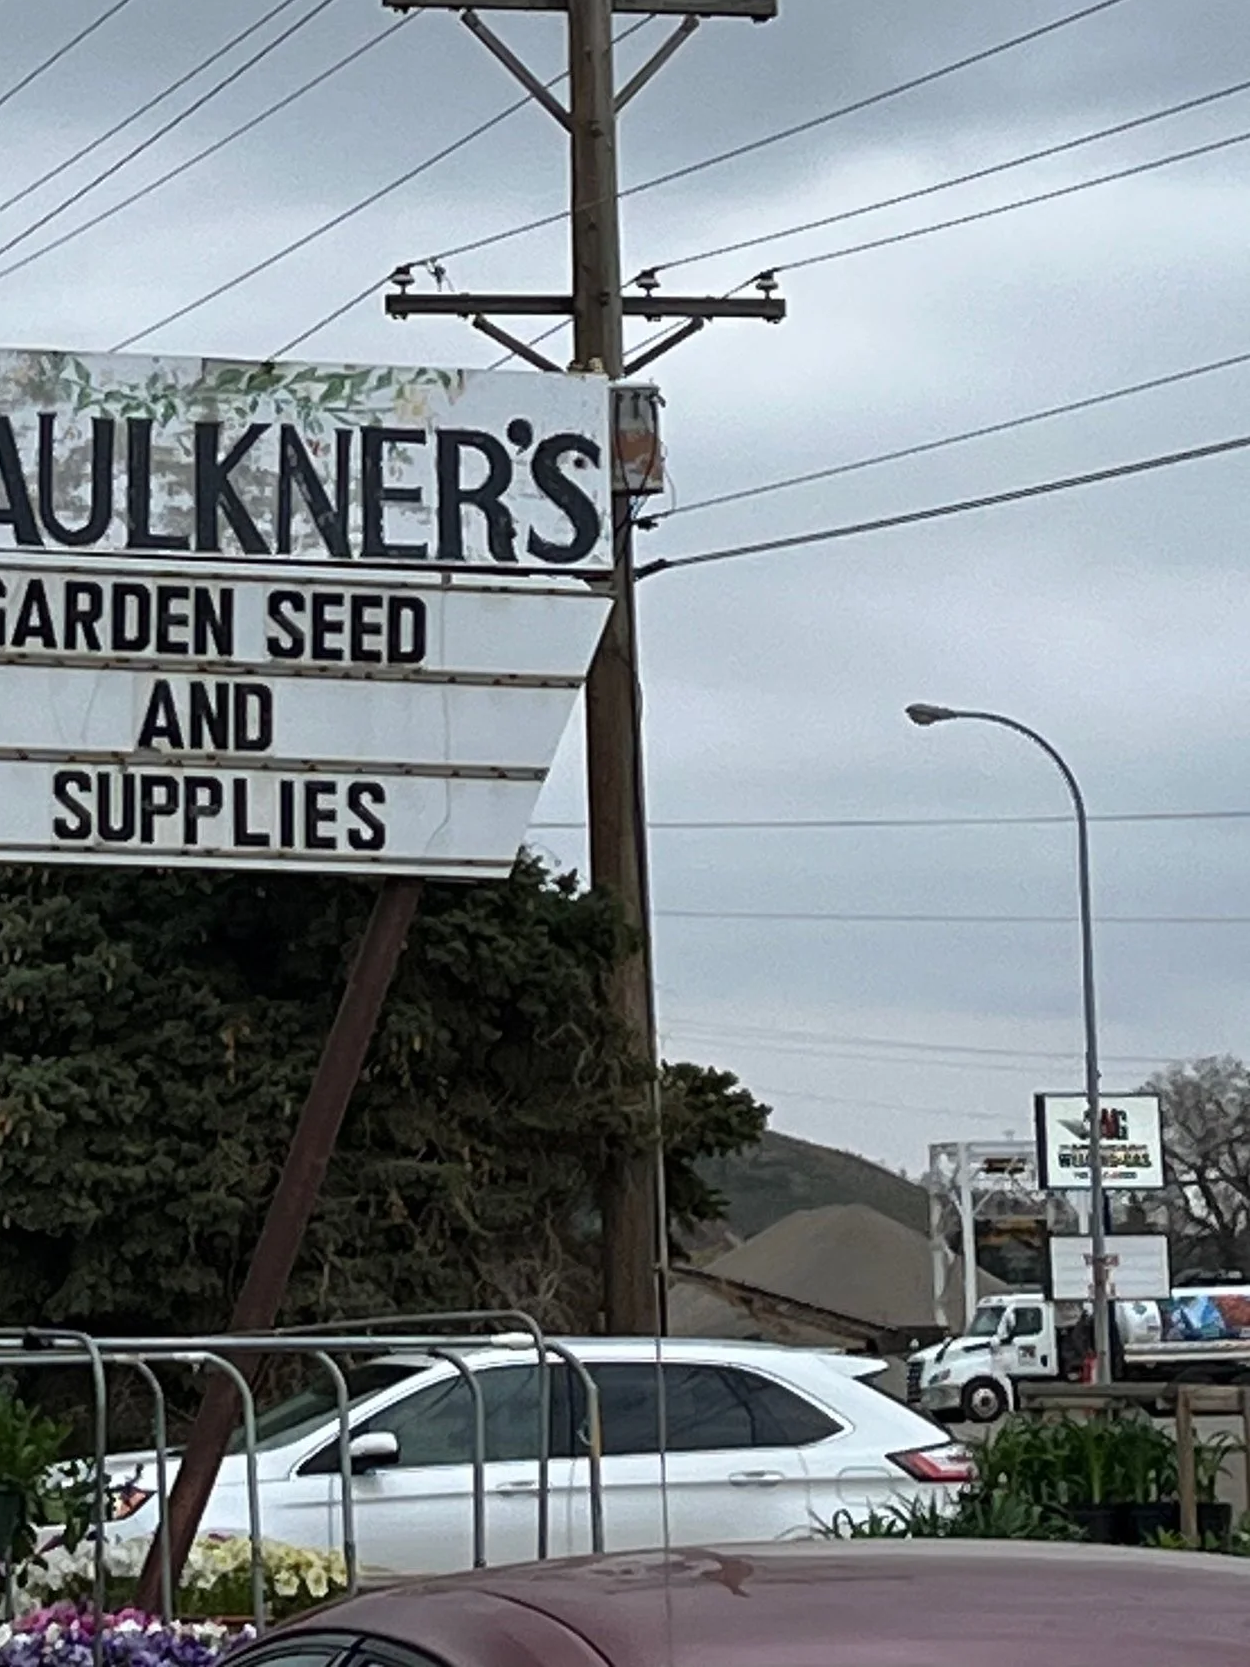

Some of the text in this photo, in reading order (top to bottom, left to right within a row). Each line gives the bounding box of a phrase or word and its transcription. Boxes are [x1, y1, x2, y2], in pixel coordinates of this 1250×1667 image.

[266, 590, 426, 665] SEED
[137, 679, 273, 752] AND
[53, 770, 386, 851] SUPPLIES
